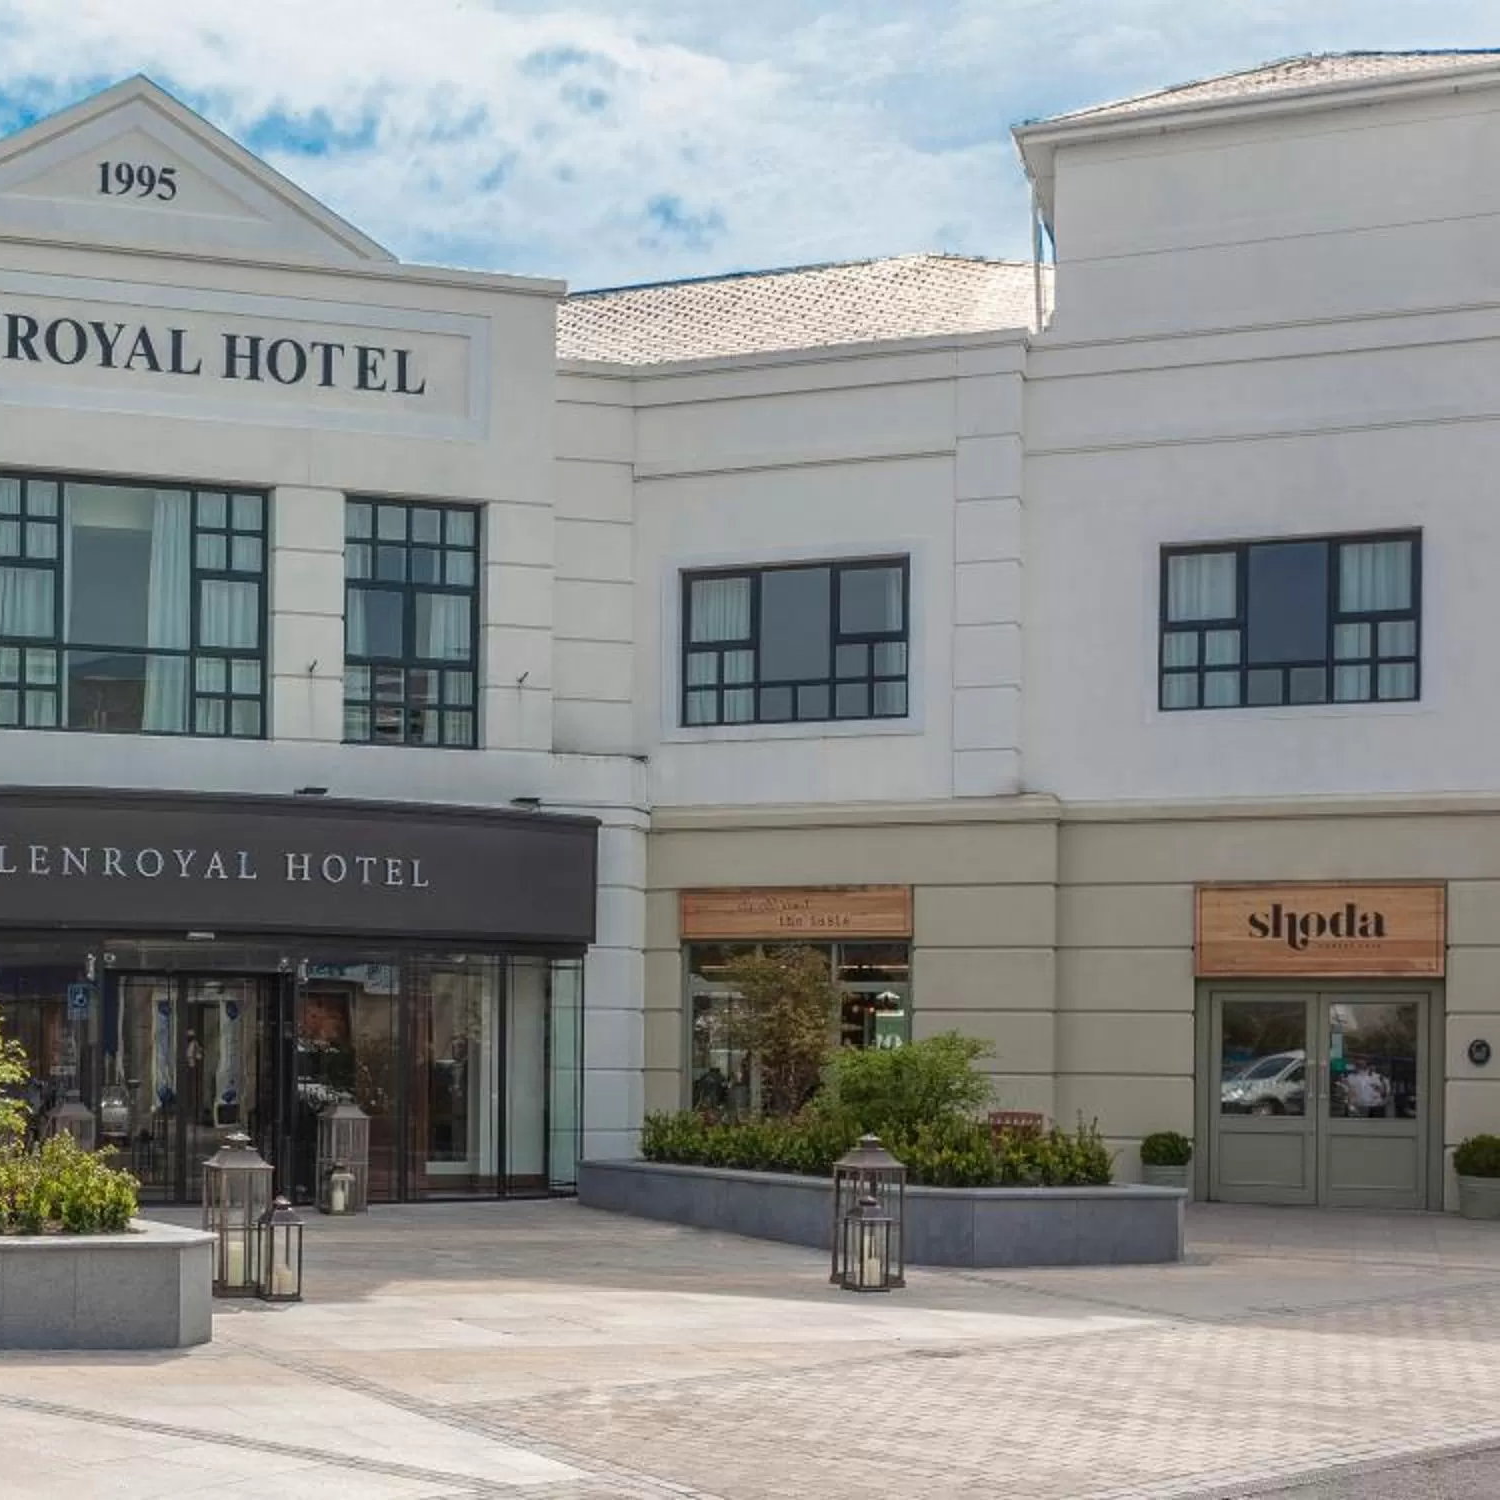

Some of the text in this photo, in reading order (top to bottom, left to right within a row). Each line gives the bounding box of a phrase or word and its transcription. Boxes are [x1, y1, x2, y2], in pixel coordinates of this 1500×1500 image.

[97, 161, 177, 201] 1995
[221, 333, 427, 396] HOTEL
[284, 852, 430, 888] HOTEL
[1248, 903, 1387, 951] shoda
